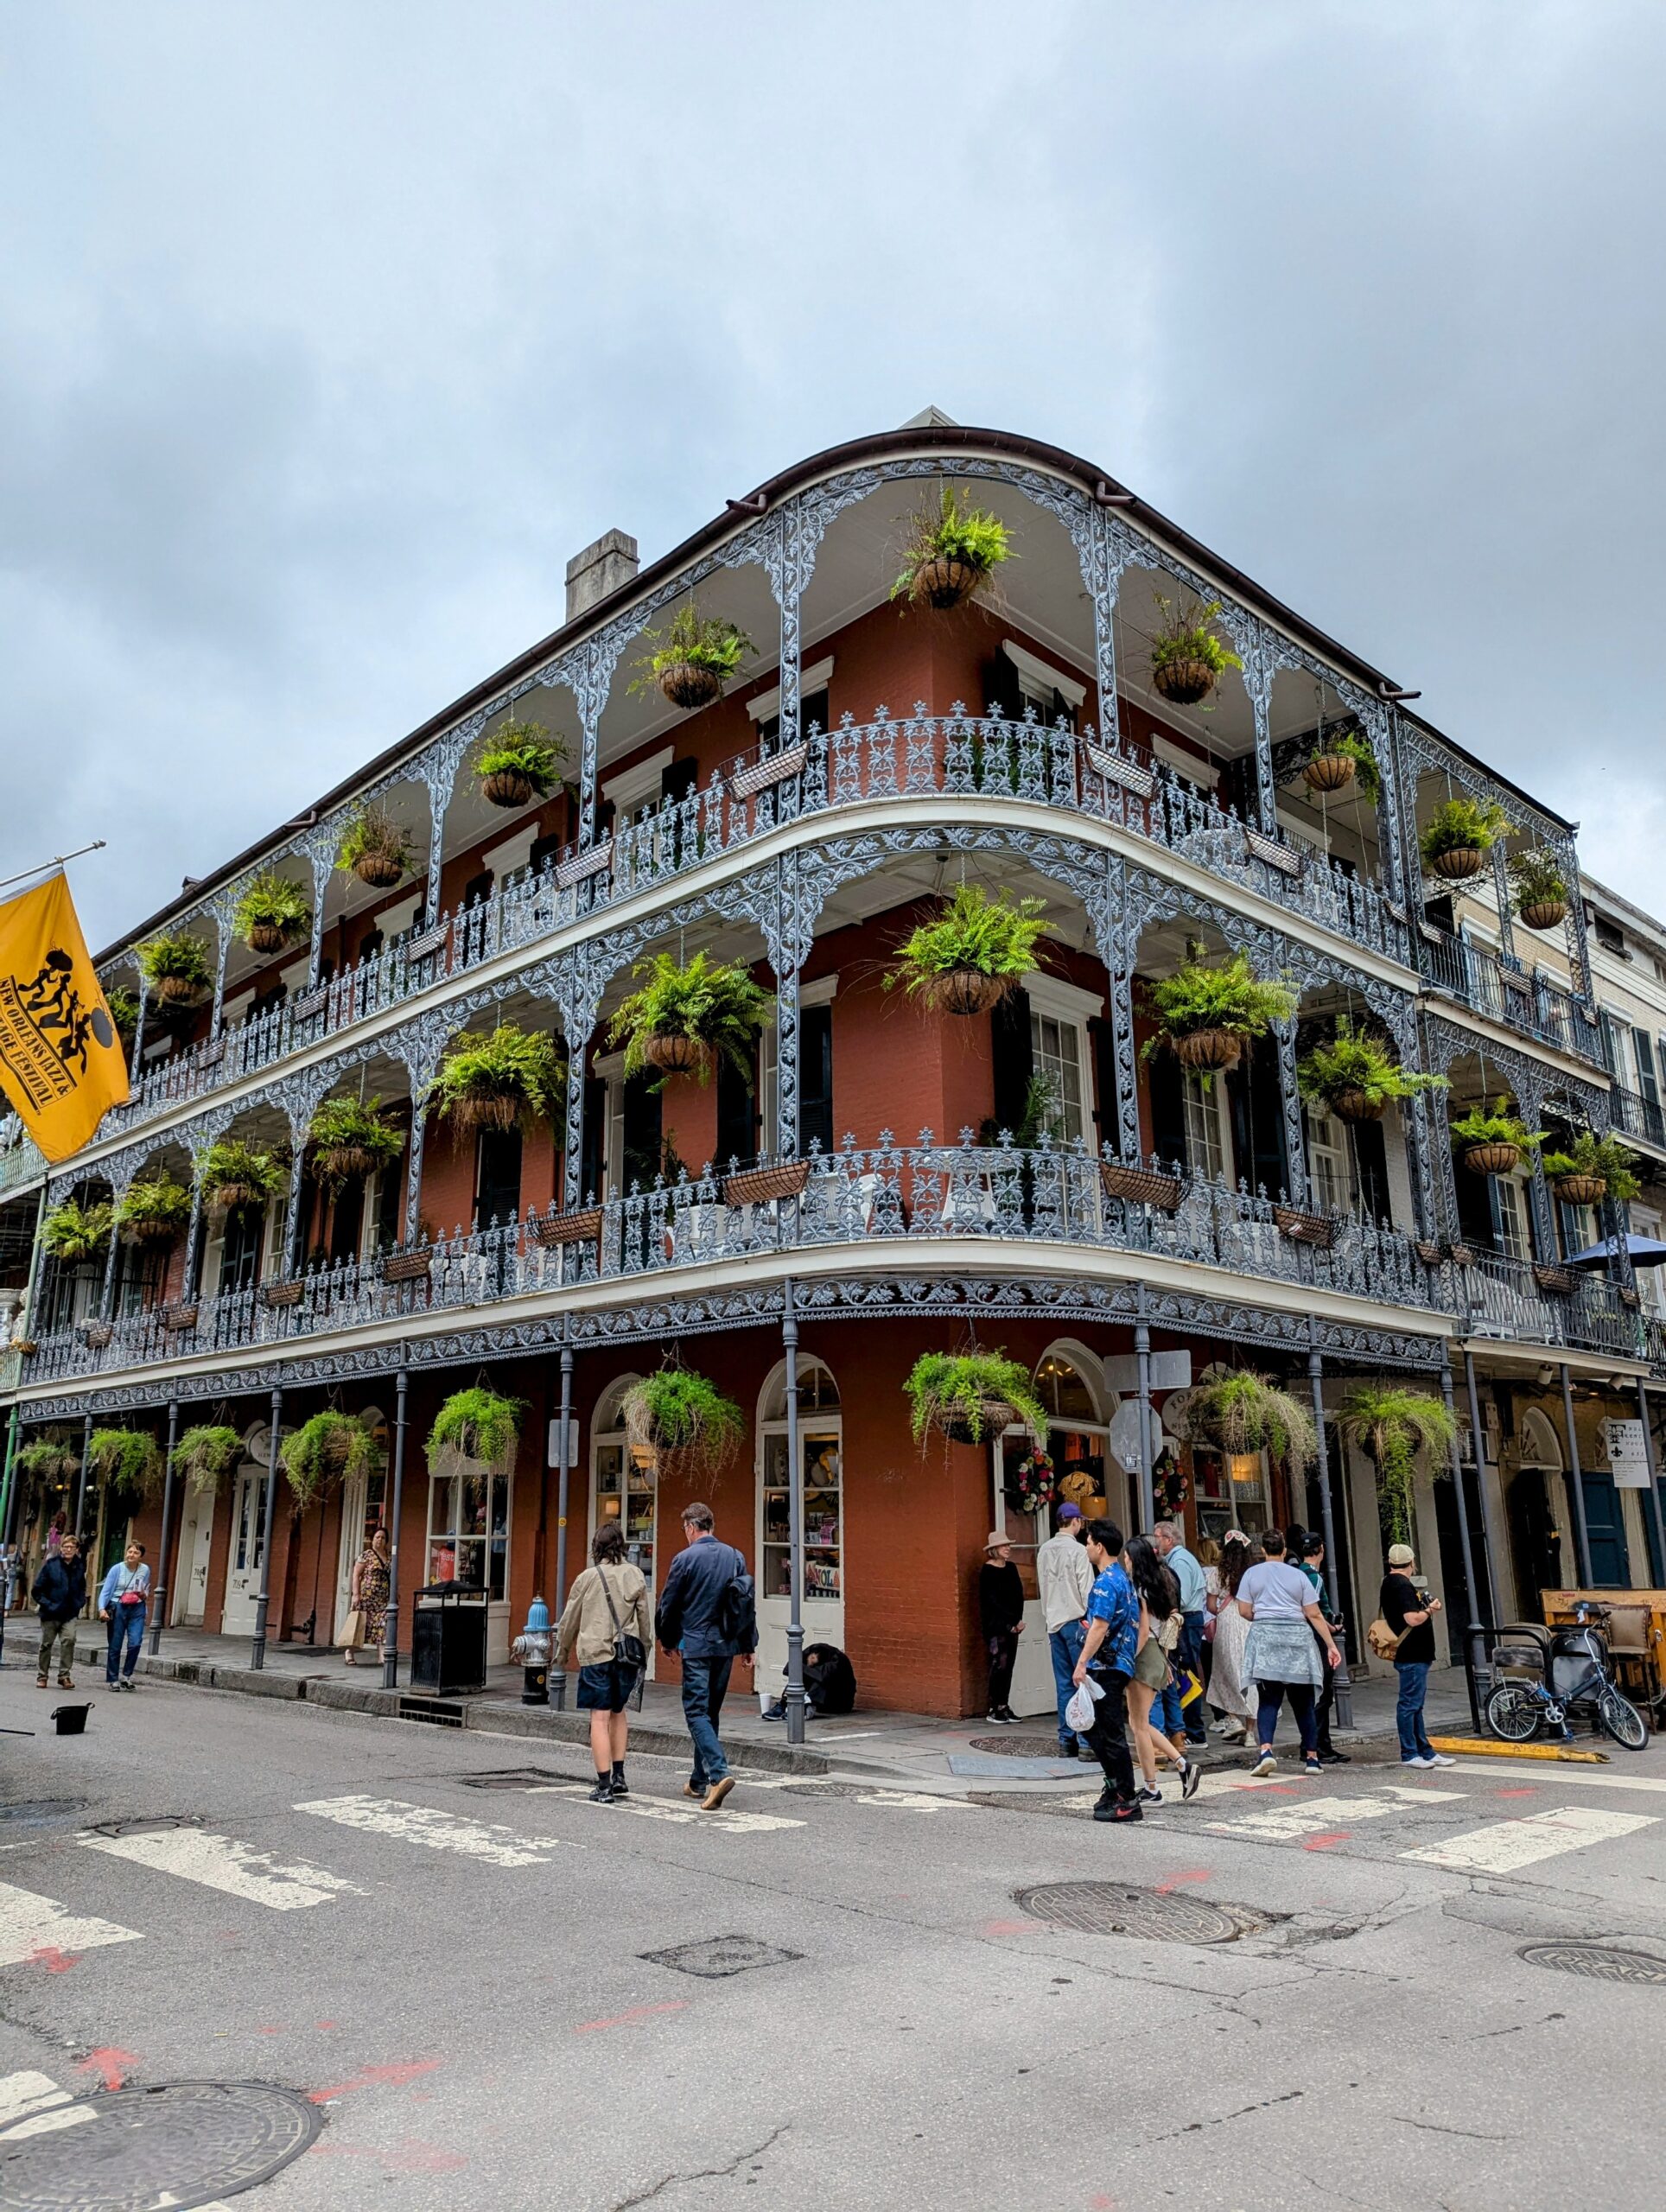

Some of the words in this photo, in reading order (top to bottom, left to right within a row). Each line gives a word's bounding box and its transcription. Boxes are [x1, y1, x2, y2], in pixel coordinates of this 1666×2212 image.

[0, 979, 16, 1006] NEW
[6, 1008, 47, 1058] ORLEANS
[10, 1050, 54, 1105] FESTIVAL
[37, 1052, 67, 1085] JAZZ
[57, 1084, 71, 1096] &
